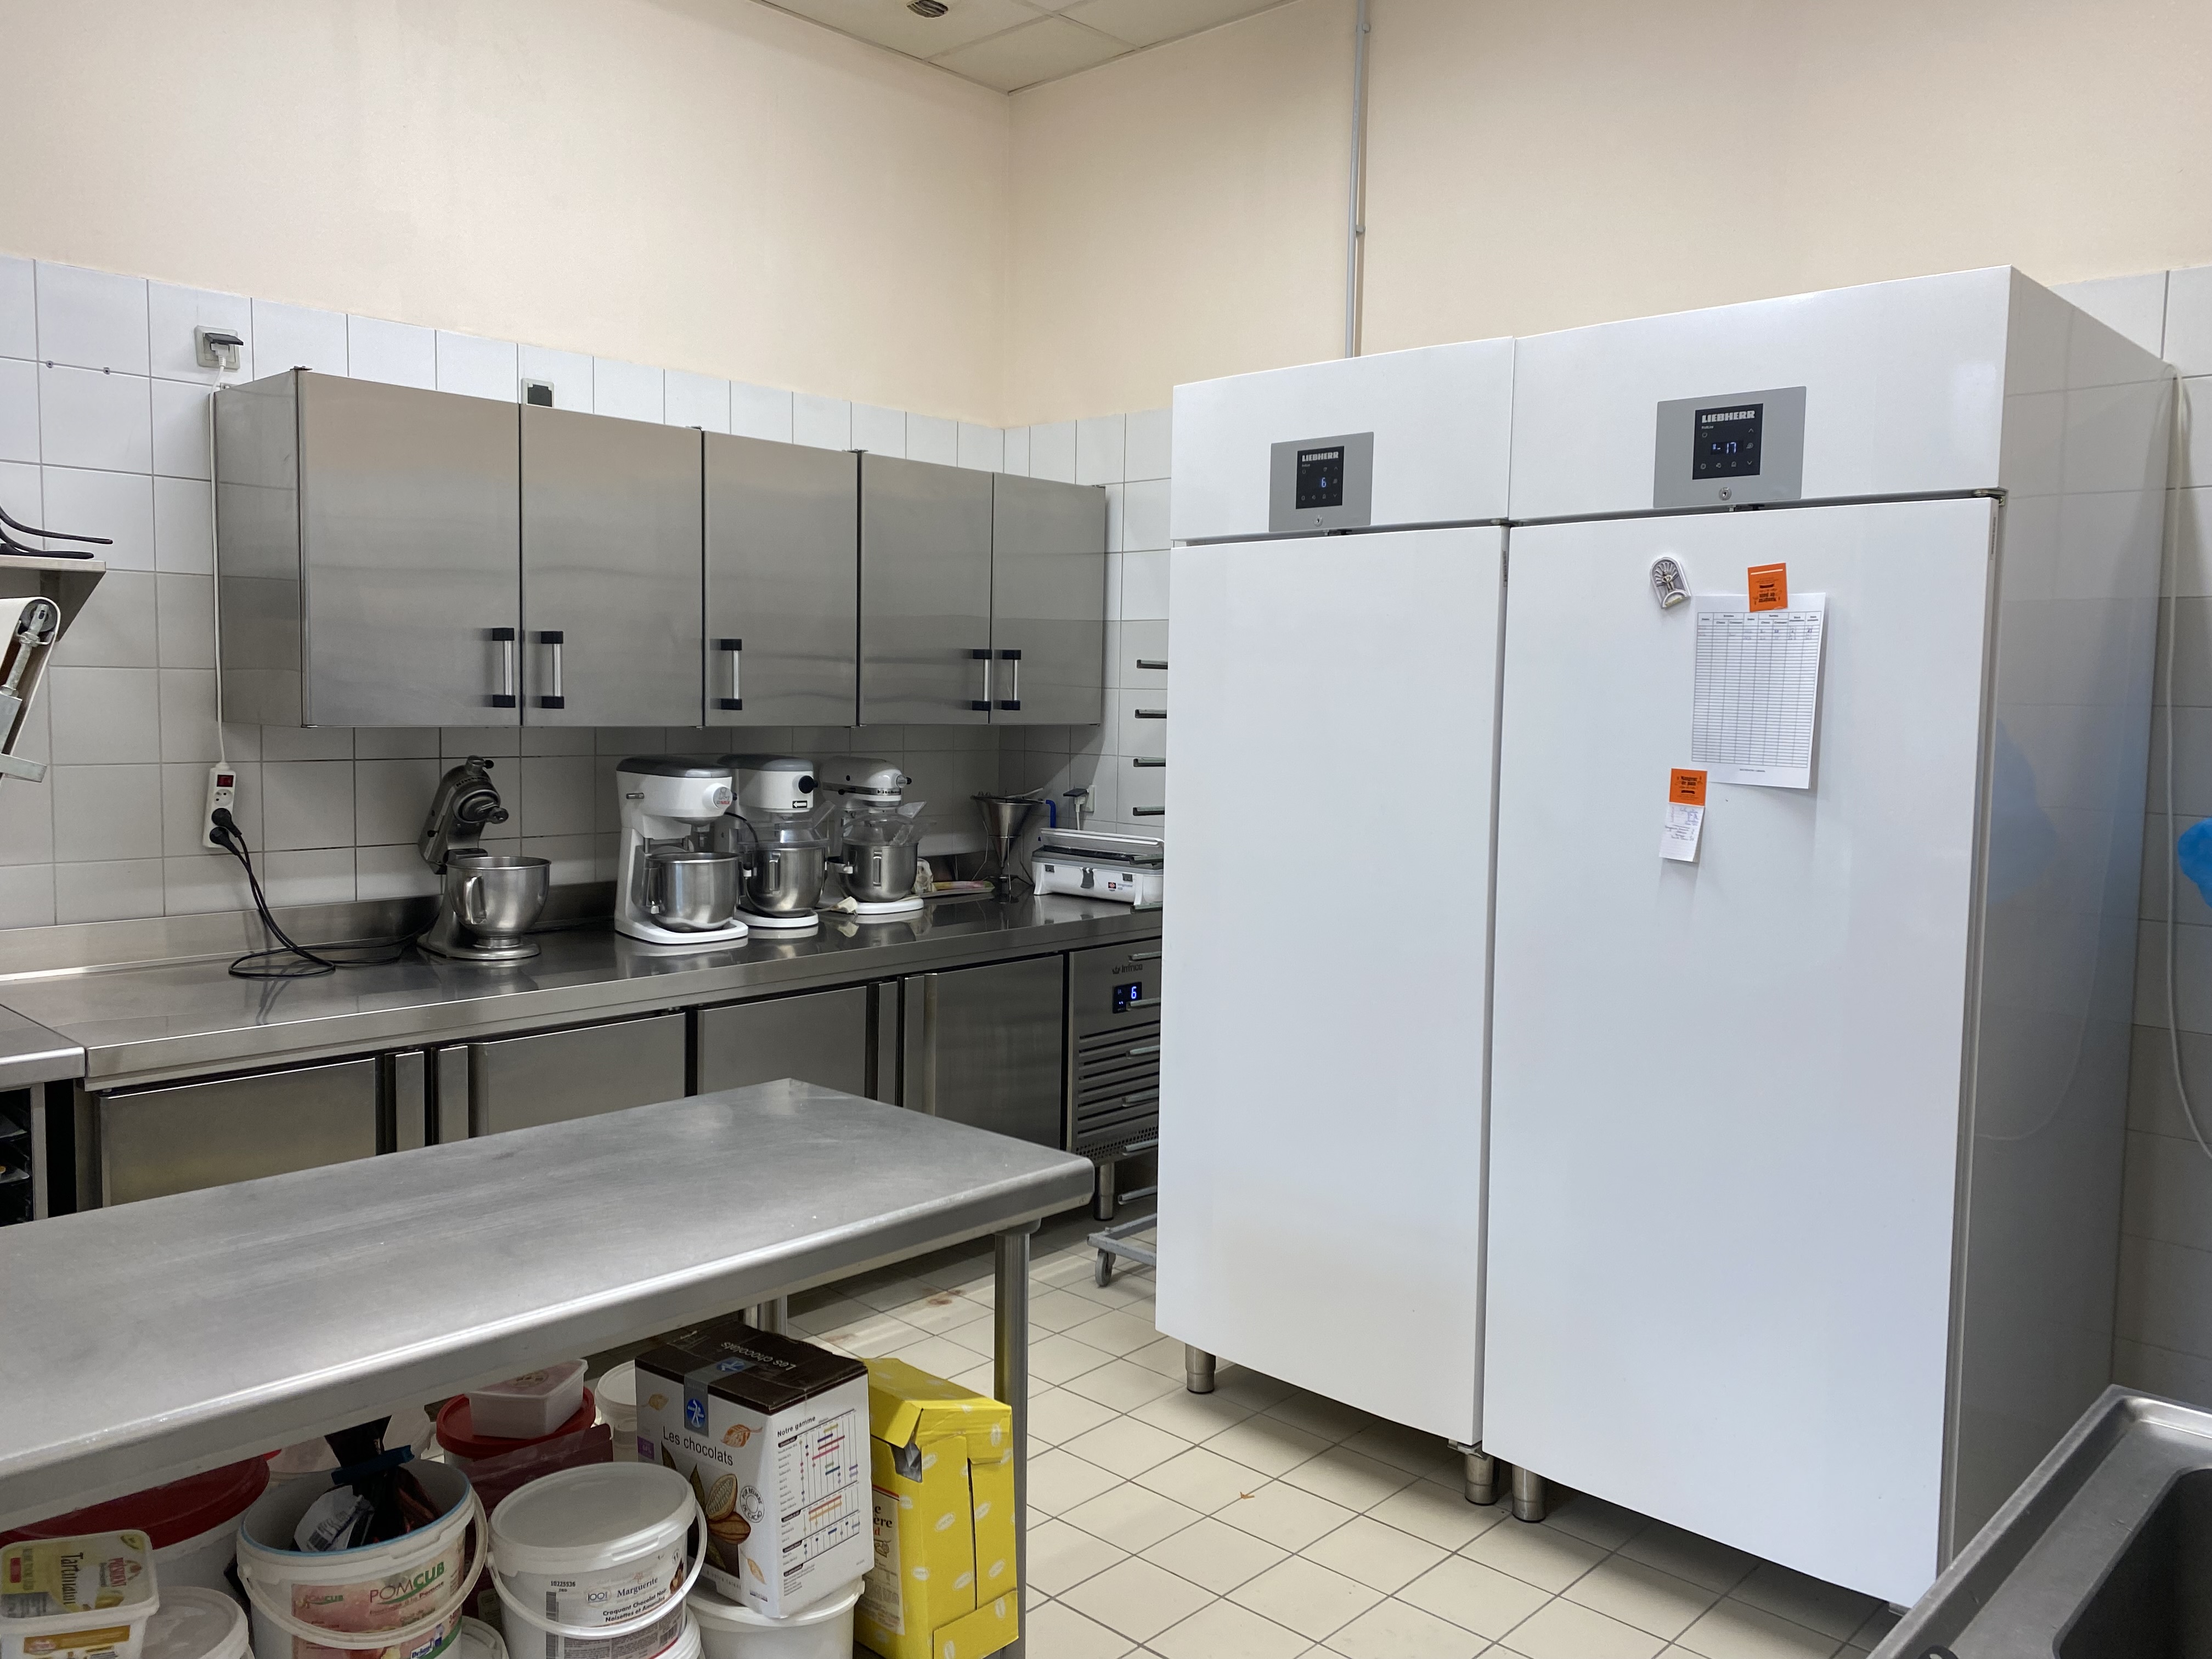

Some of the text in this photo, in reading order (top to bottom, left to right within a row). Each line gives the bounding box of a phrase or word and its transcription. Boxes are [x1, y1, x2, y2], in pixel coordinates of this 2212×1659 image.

[1701, 410, 1755, 423] LIEBHERR
[1302, 452, 1339, 462] LIEBHERR
[1321, 477, 1327, 488] 6
[1131, 986, 1137, 999] 6
[721, 1342, 797, 1372] Les chocolats
[777, 1416, 816, 1437] Notre gamme
[663, 1426, 680, 1446] Les
[684, 1436, 733, 1466] chocolats
[370, 1561, 445, 1602] POMCUB
[617, 1577, 658, 1598] Marguerite
[603, 1588, 667, 1616] Craquant Chocolat Noir
[606, 1610, 634, 1622] Noisettes
[642, 1596, 665, 1611] Amandes
